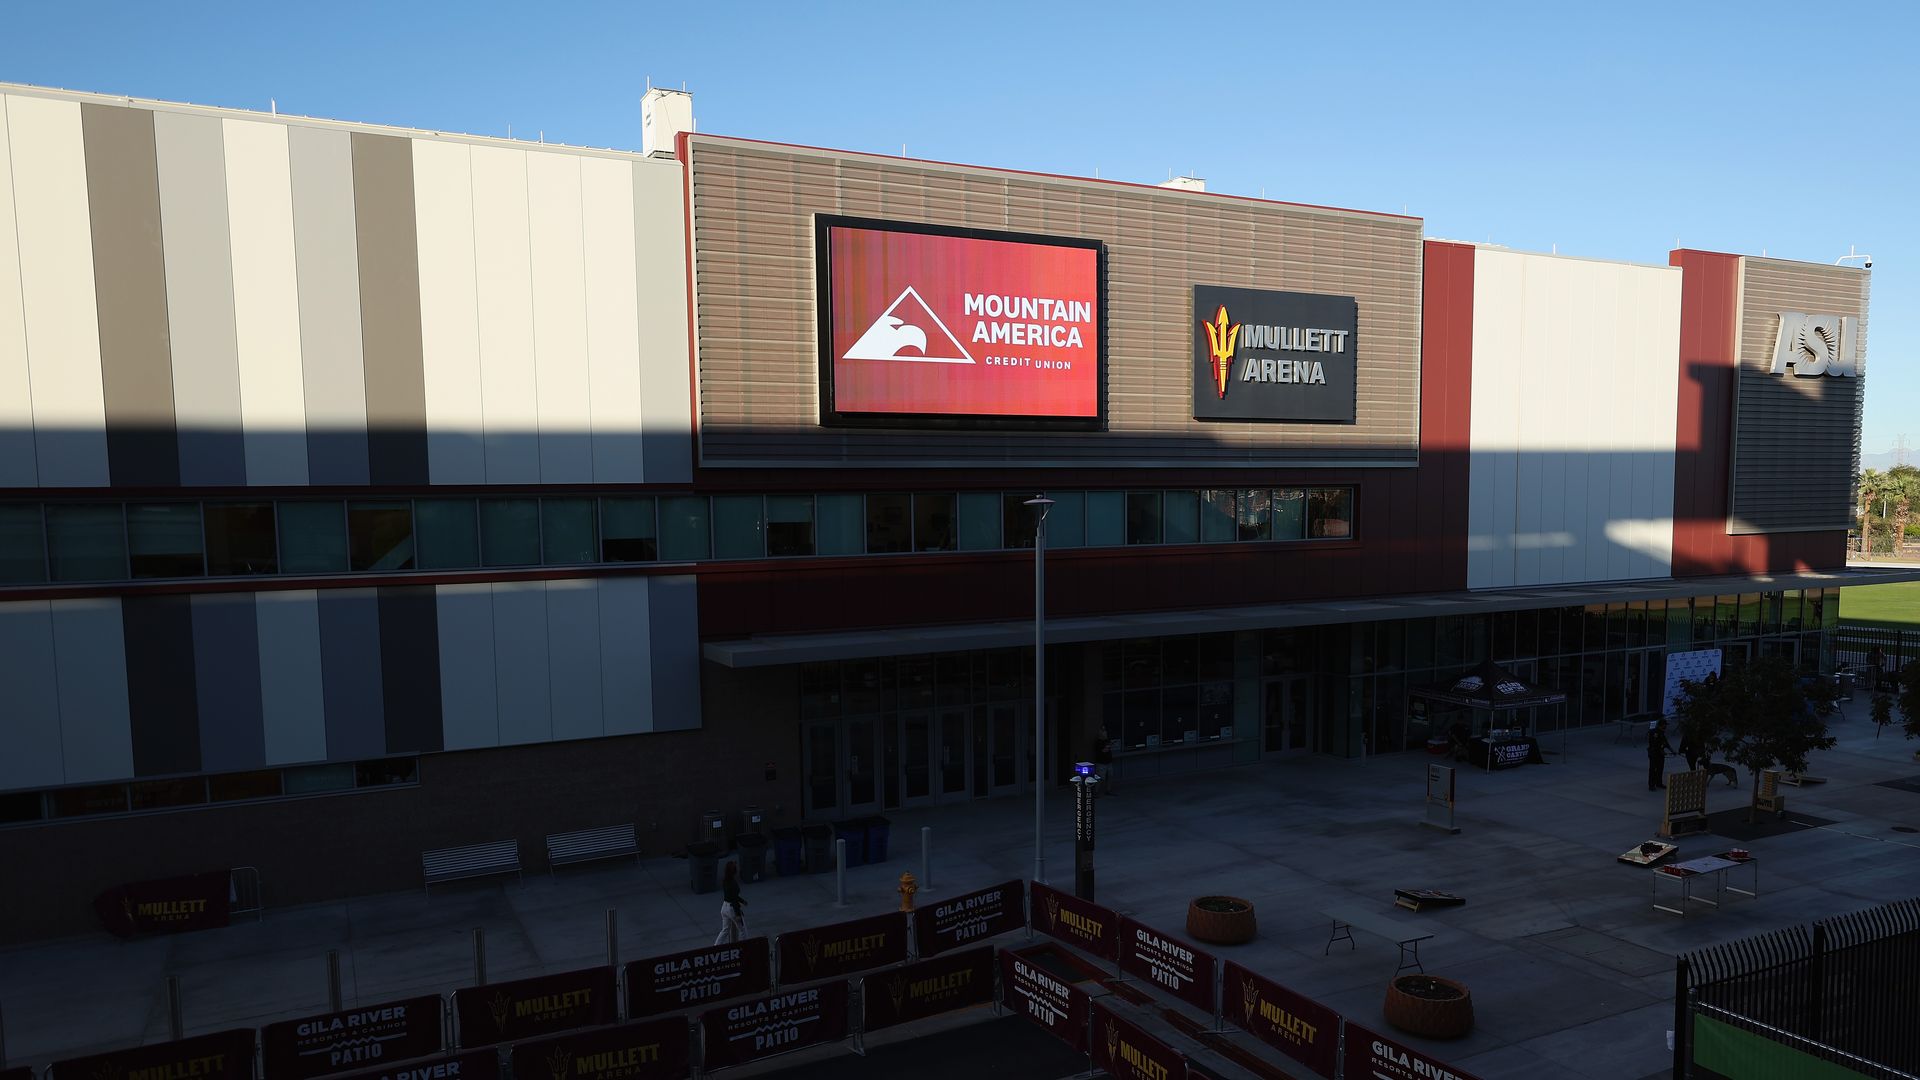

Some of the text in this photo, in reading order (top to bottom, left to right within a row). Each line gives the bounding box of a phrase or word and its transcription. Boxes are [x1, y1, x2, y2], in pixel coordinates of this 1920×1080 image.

[964, 293, 1091, 323] MOUNTAIN
[972, 321, 1083, 348] AMERICA
[1242, 324, 1349, 353] MULLETT
[1770, 312, 1858, 378] ASU
[985, 356, 1071, 370] CREDIT UNION
[1241, 358, 1327, 385] ARENA
[137, 899, 207, 916] MULLETT
[935, 888, 1001, 918] GILA RIVER
[956, 922, 988, 941] PATIO
[1060, 908, 1103, 938] MULLETT
[823, 933, 886, 958] MULLETT
[1135, 942, 1162, 958] RESORTS
[1168, 957, 1194, 973] CASINOS
[1136, 929, 1193, 965] GILA RIVER
[654, 948, 741, 975] GILA RIVER
[910, 969, 972, 998] MULLETT
[1014, 961, 1069, 1000] GILA RIVER
[1151, 965, 1179, 990] PATIO
[515, 987, 592, 1017] MULLETT
[680, 982, 721, 1003] PATIO
[727, 989, 819, 1021] GILA RIVER
[297, 1006, 406, 1036] GILA RIVER
[1028, 999, 1054, 1027] PATIO
[1260, 998, 1317, 1044] MULLETT
[755, 1026, 799, 1051] PATIO
[1270, 1024, 1301, 1046] ARENA
[330, 1042, 383, 1067] PATIO
[576, 1043, 660, 1074] MULLETT
[1120, 1040, 1168, 1080] MULLETT
[1371, 1057, 1413, 1080] RESORTS
[1372, 1040, 1411, 1069] GILA
